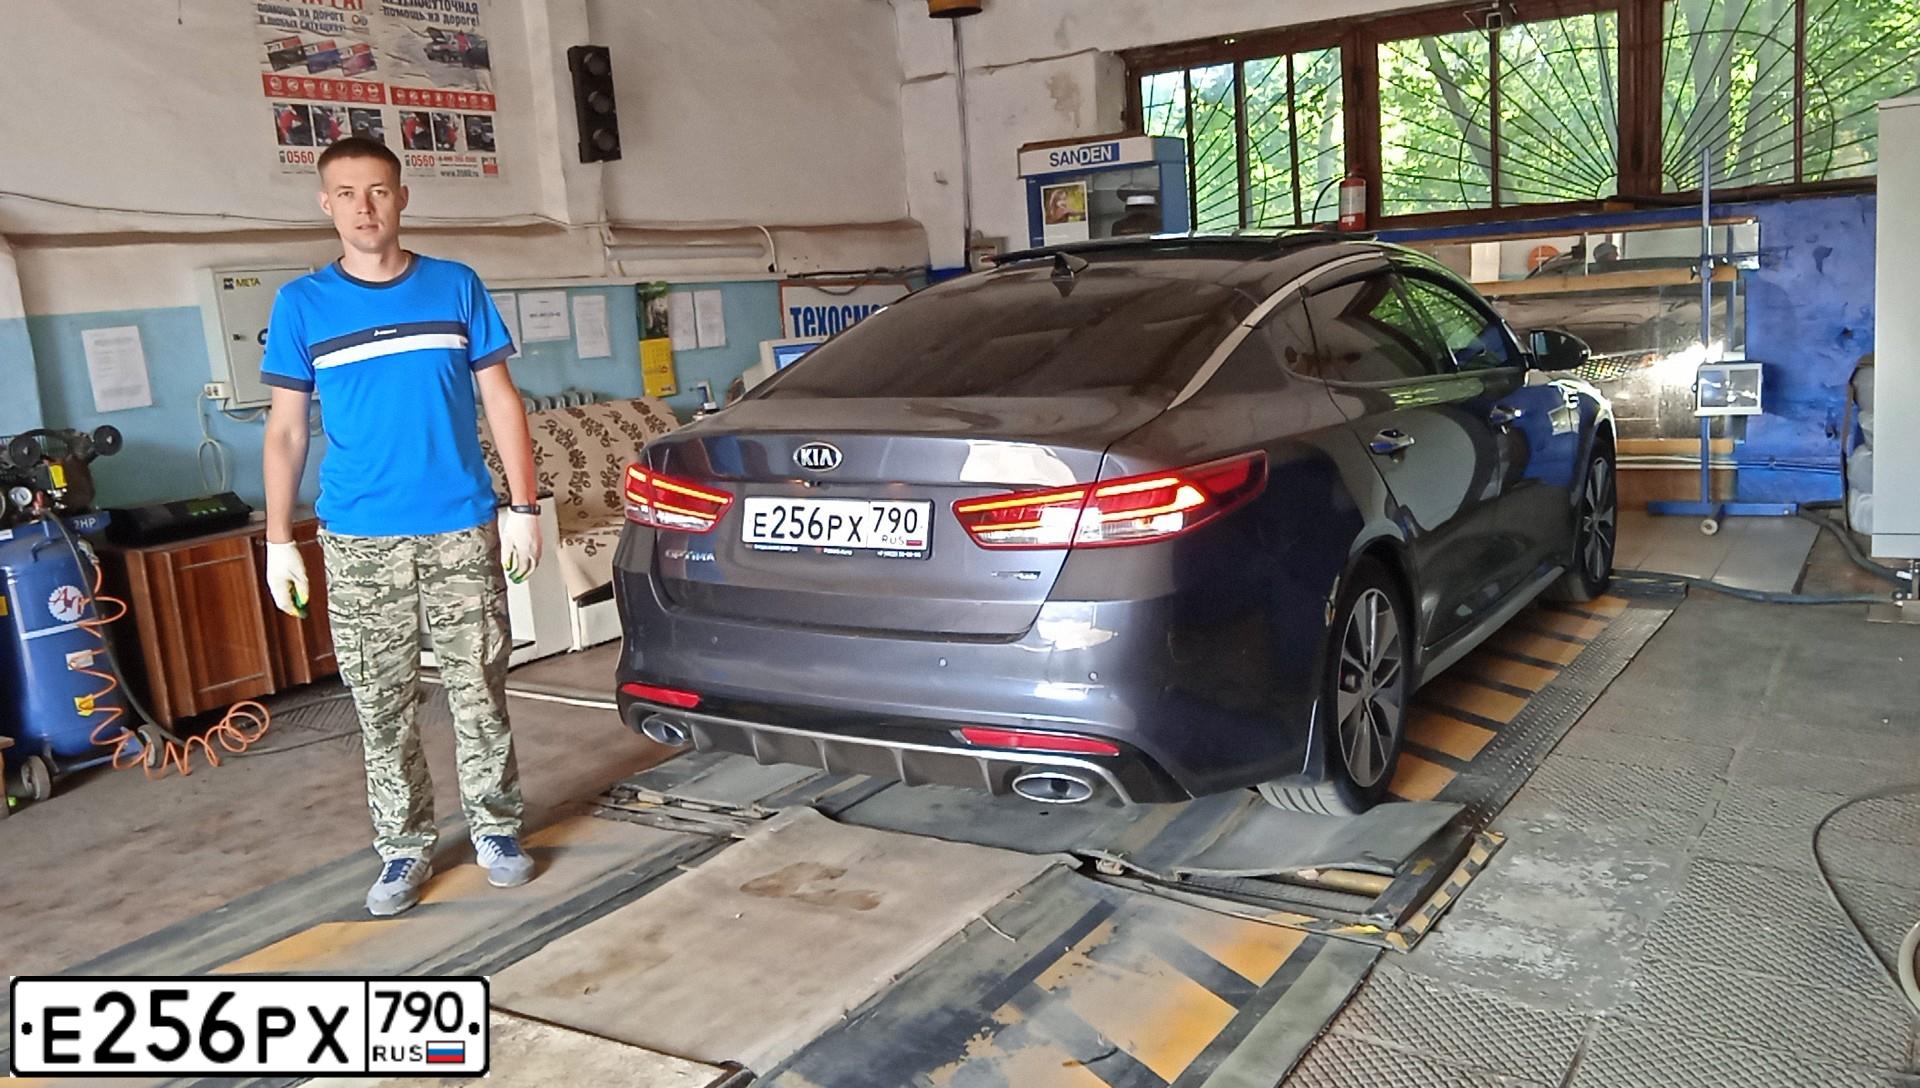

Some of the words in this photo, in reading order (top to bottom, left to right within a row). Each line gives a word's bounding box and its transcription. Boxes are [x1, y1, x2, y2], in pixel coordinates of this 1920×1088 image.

[287, 151, 315, 164] 0560
[411, 154, 435, 167] 0560
[1050, 145, 1112, 167] SANDEN
[800, 448, 834, 466] KIA
[872, 506, 918, 534] 790
[881, 534, 905, 546] RUS
